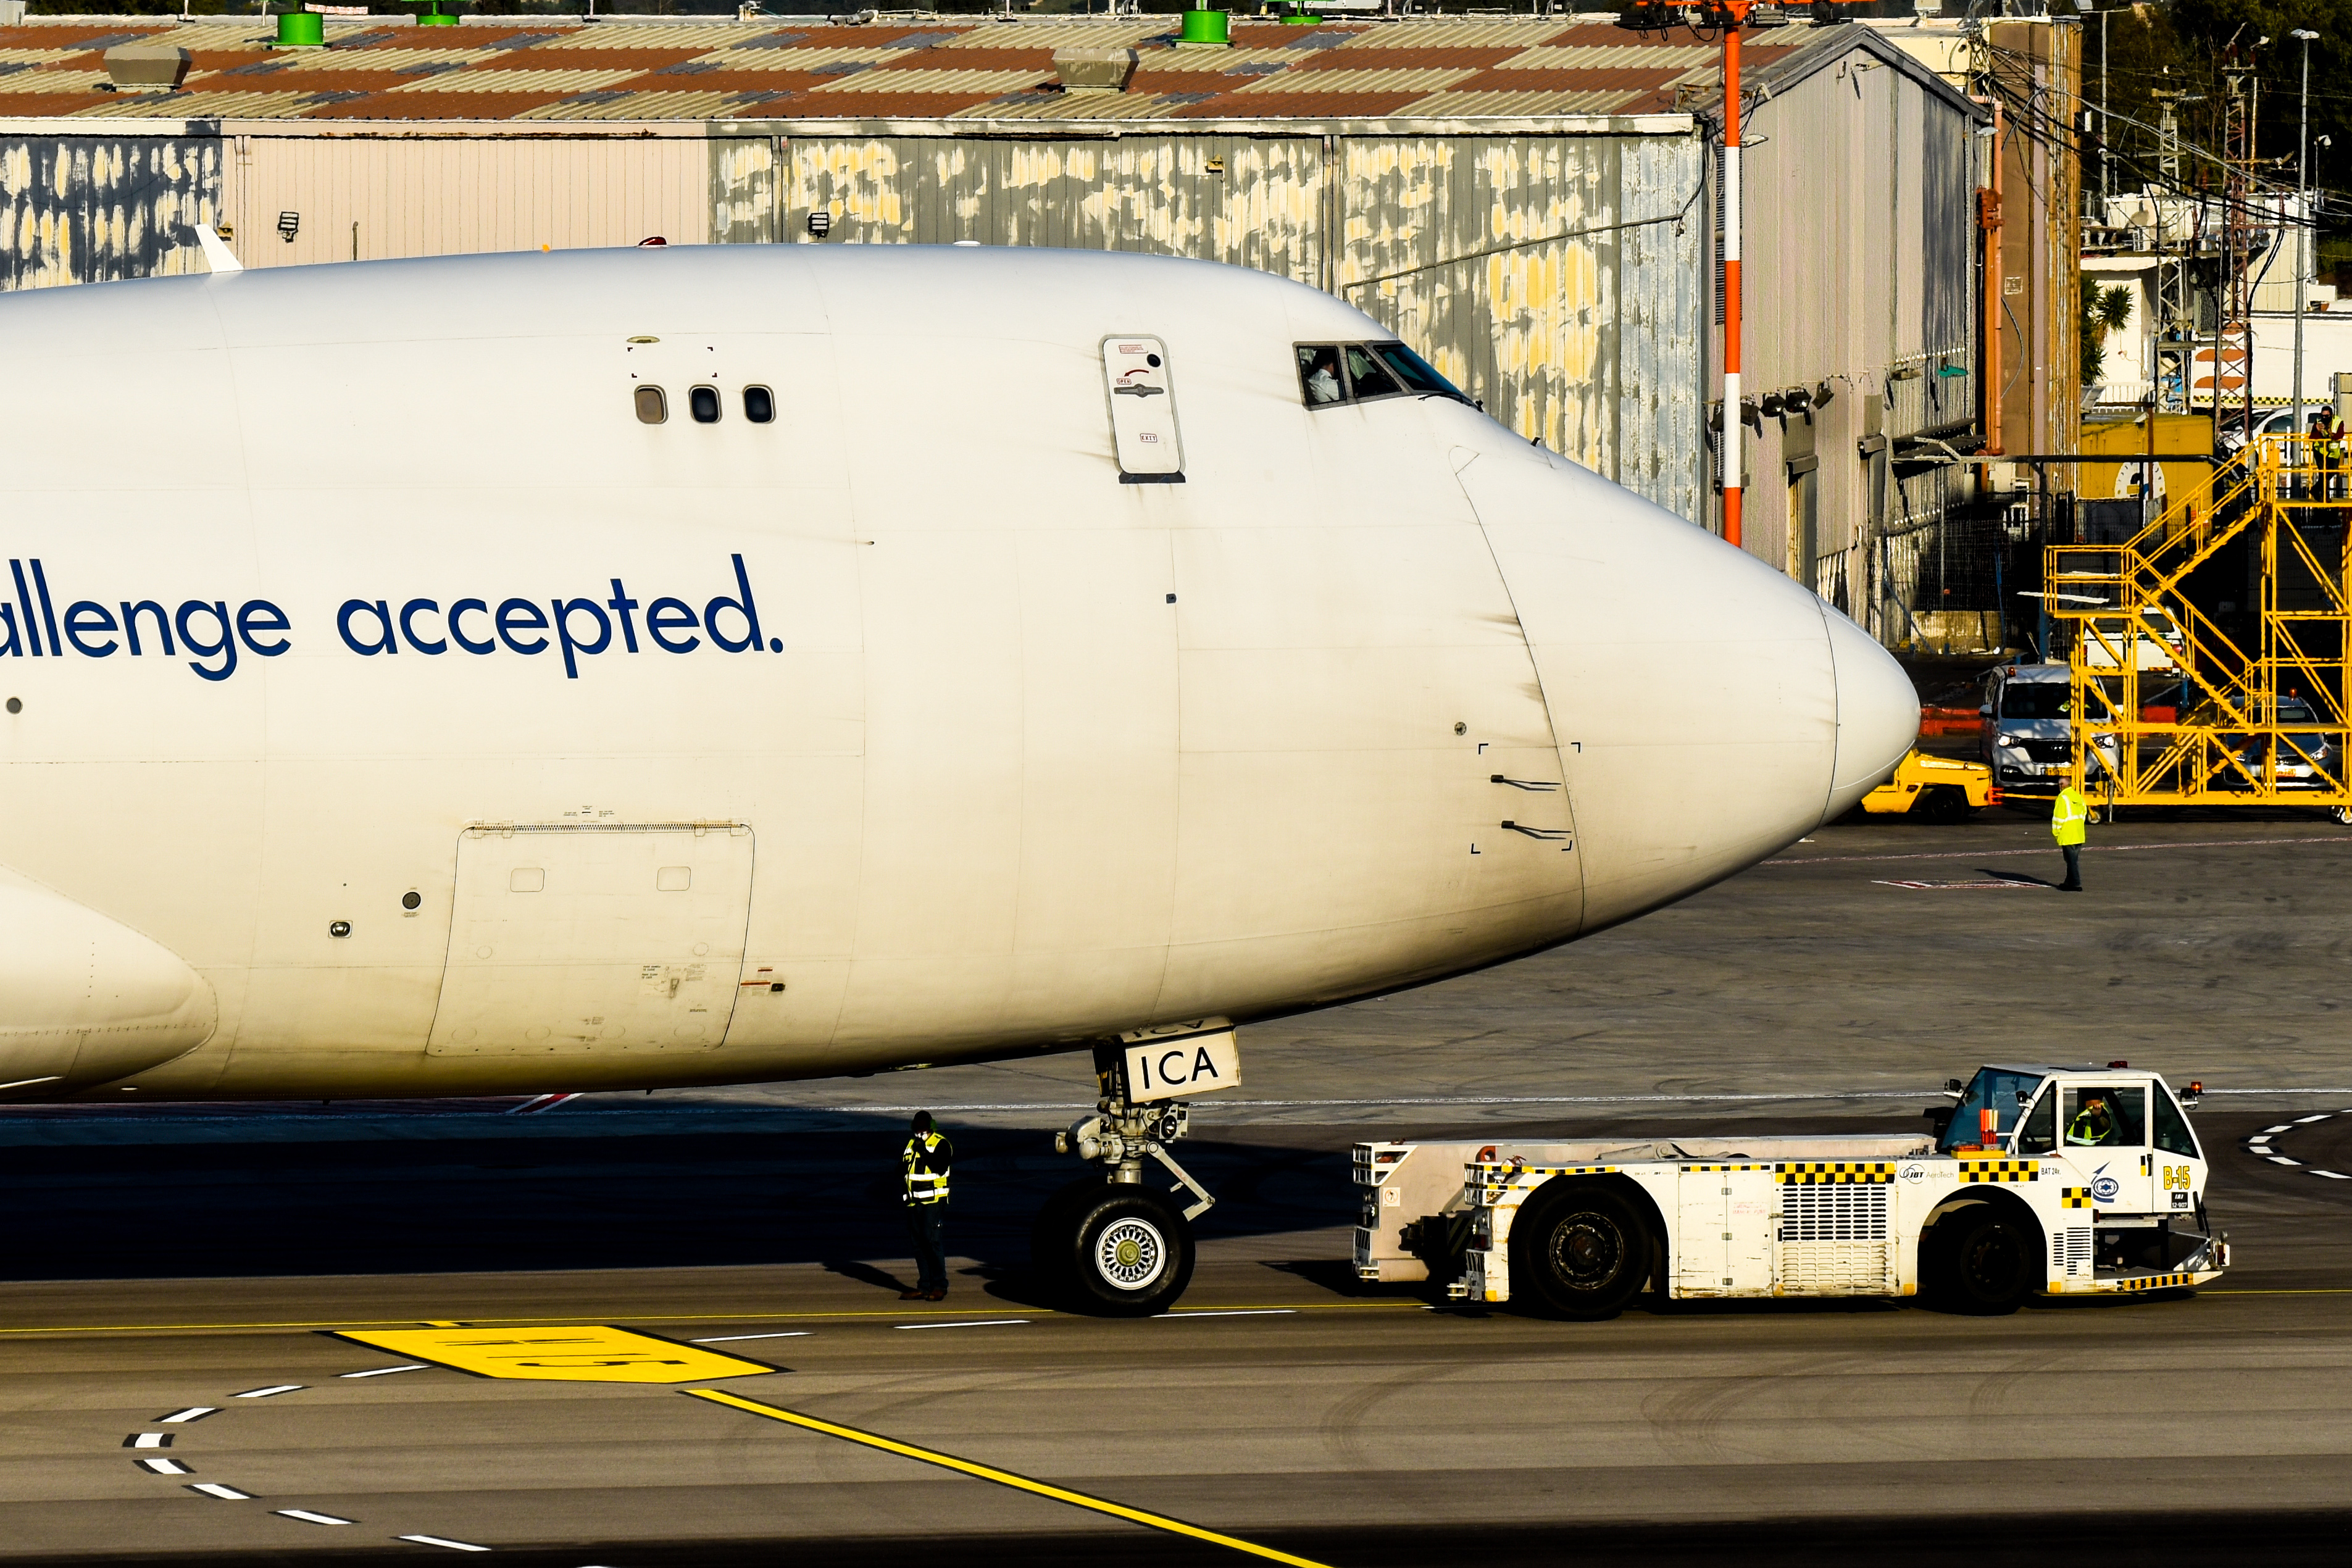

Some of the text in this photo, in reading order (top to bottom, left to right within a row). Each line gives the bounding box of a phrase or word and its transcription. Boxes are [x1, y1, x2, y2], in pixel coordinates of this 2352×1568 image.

[336, 553, 784, 679] accepted.
[1141, 1046, 1219, 1090] ICA
[2163, 1166, 2190, 1190] B-15
